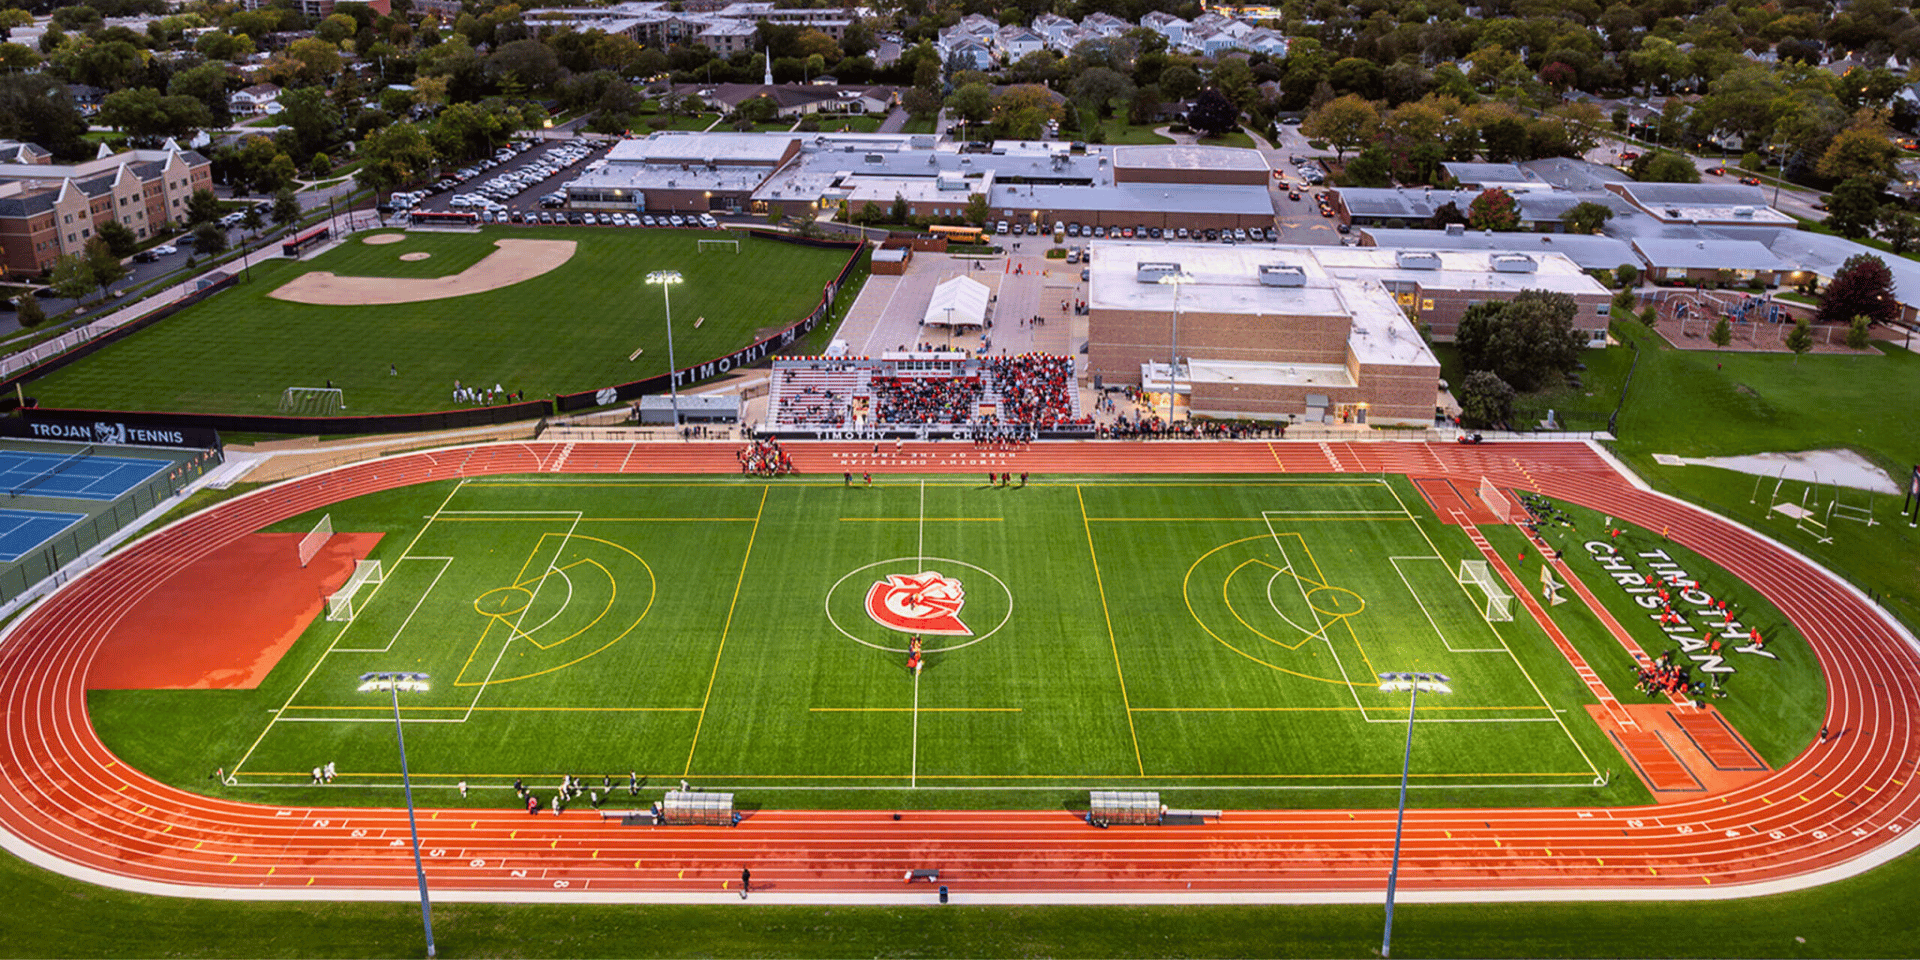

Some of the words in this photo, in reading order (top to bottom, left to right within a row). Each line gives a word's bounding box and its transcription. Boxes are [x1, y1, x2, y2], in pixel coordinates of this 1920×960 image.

[674, 341, 768, 387] TIMOTHY
[30, 423, 91, 438] TROJAN
[128, 429, 184, 444] TENNIS
[816, 431, 886, 440] TIMOTHY
[1583, 540, 1737, 673] CHRISTIAN
[1637, 548, 1777, 660] TIMOTHY
